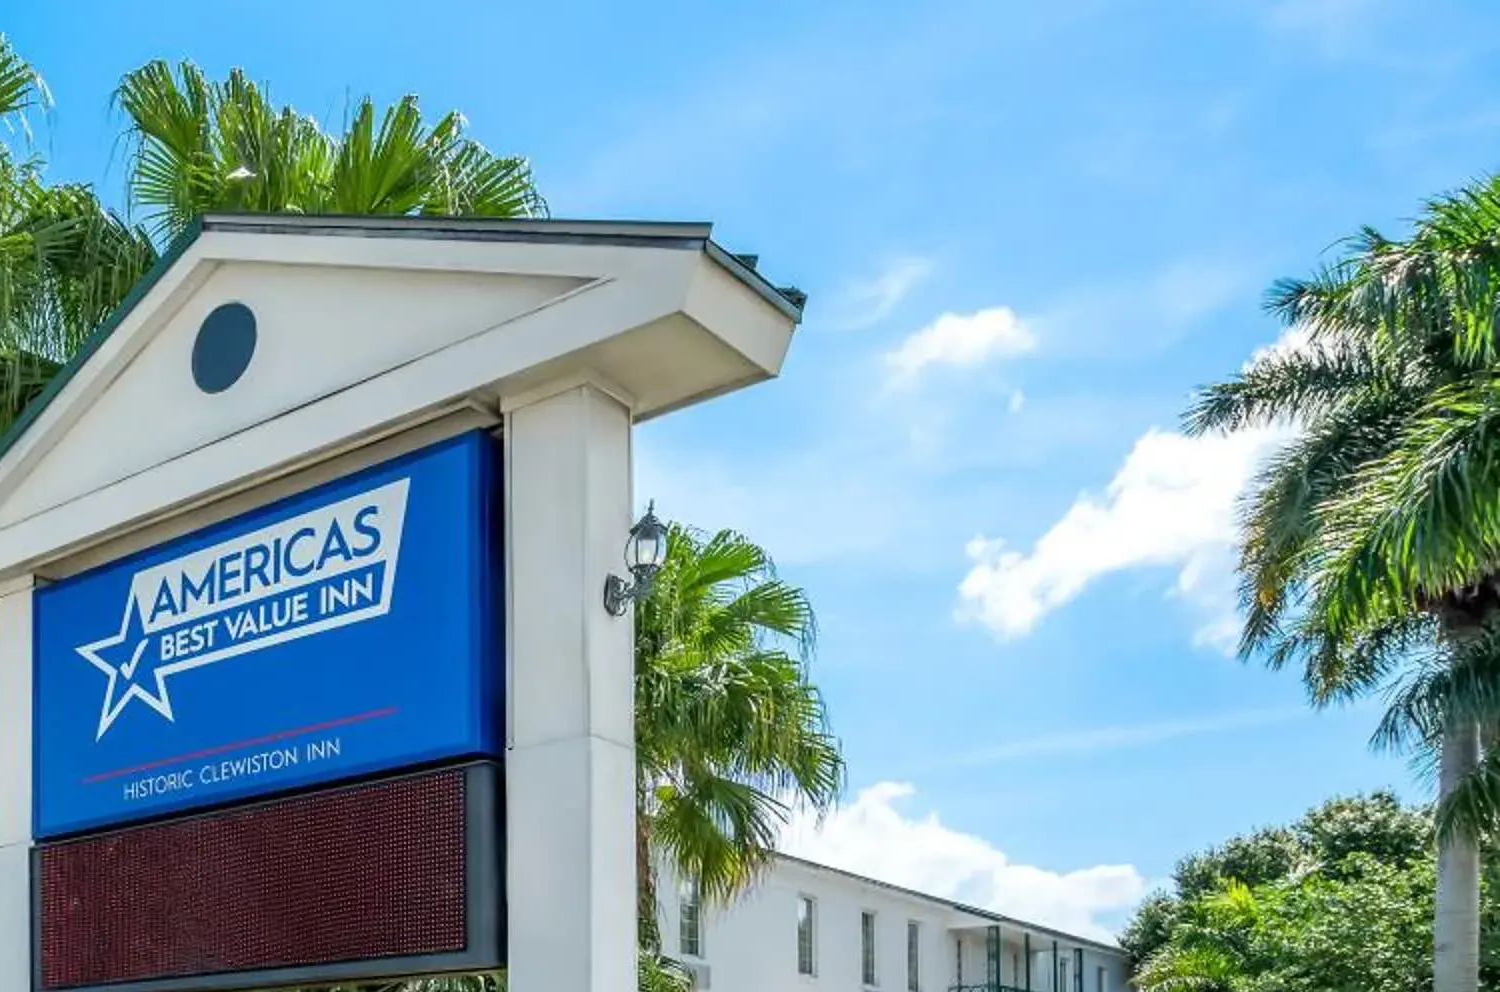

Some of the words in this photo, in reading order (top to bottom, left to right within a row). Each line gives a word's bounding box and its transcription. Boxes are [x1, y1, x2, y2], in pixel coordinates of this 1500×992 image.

[149, 505, 381, 624] AMERICAS
[161, 619, 219, 661] BEST
[224, 592, 309, 641] VALUE
[320, 572, 373, 614] INN
[124, 769, 194, 799] HISTORIC
[199, 747, 298, 785] CLEWISTON
[307, 738, 341, 762] INN
